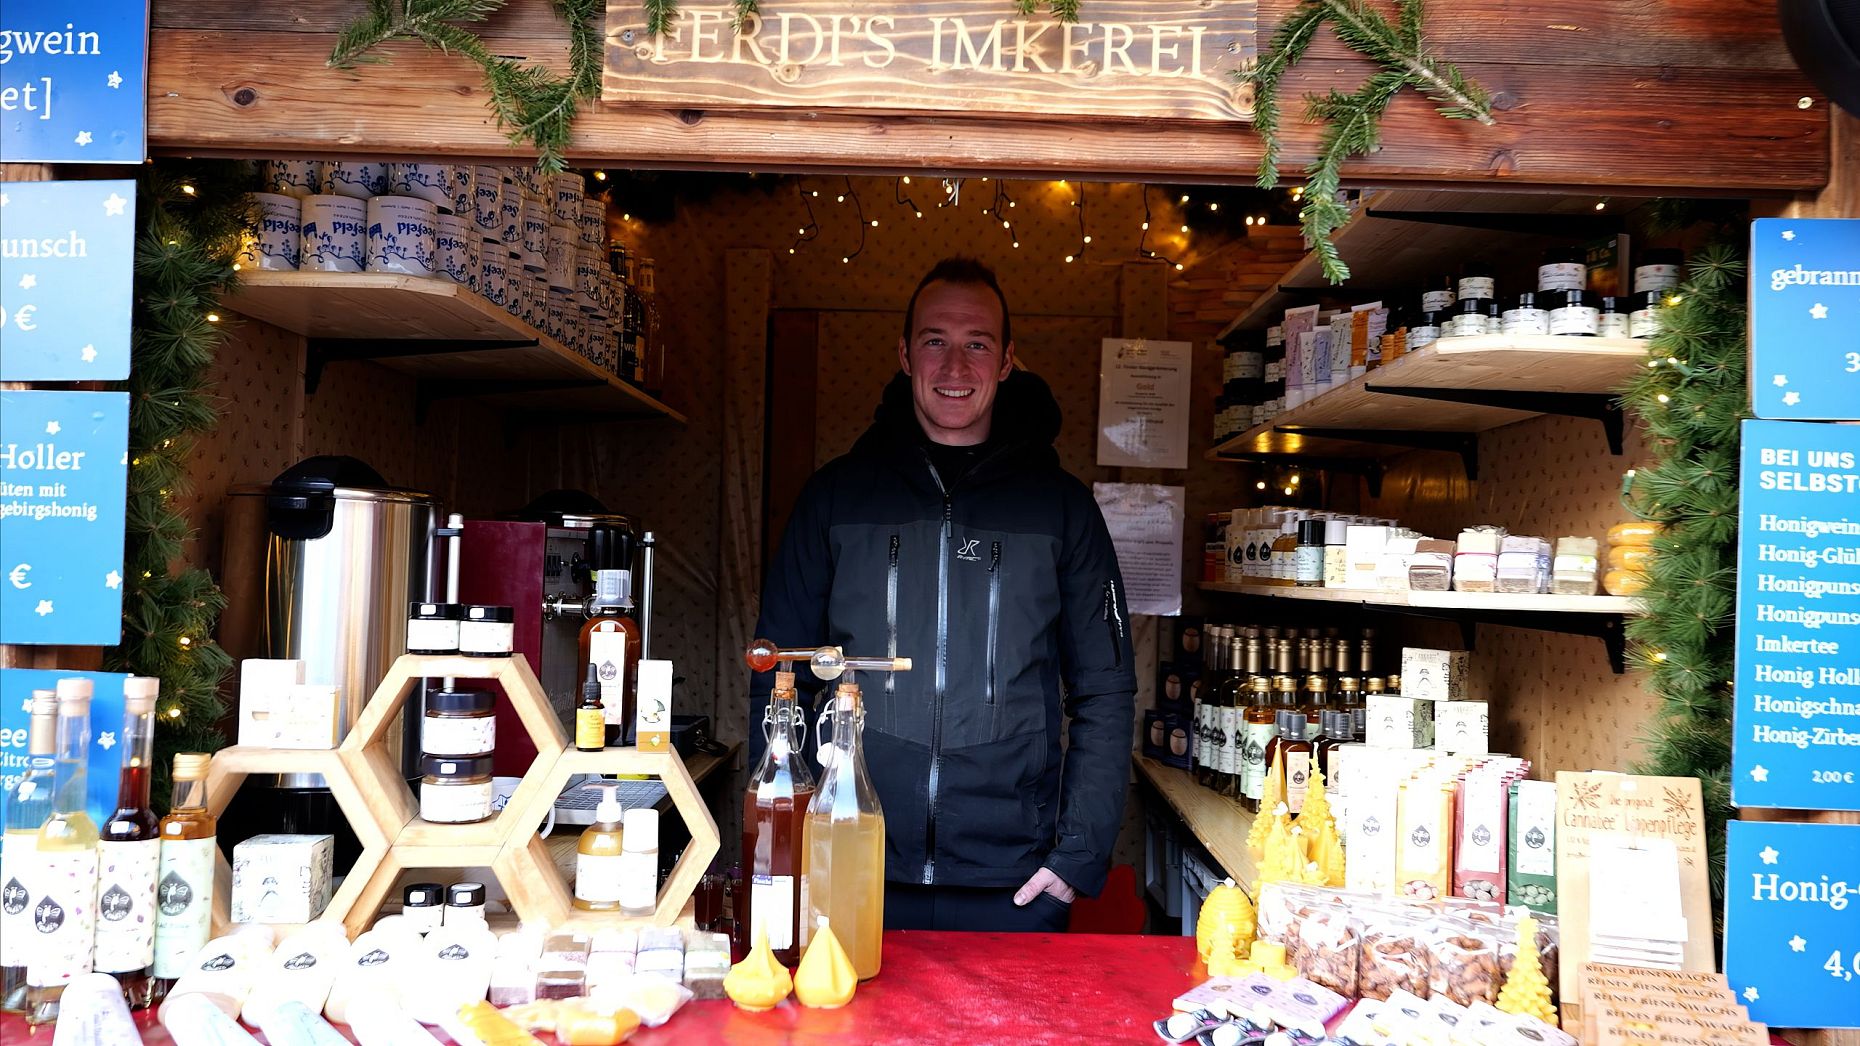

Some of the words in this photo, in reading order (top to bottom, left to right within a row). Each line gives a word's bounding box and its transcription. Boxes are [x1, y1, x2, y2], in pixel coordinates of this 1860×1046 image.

[652, 6, 895, 68] FERDI'S
[929, 17, 1207, 78] IMKEREI
[1761, 448, 1799, 466] BEI
[1808, 450, 1855, 469] UNS
[39, 482, 67, 497] mit
[1760, 470, 1860, 494] SELBST
[1759, 514, 1860, 538] Honigwein
[9, 564, 32, 589] €
[1755, 634, 1839, 654] Imkertee
[1755, 664, 1814, 688] Honig
[1752, 873, 1860, 911] Honig-
